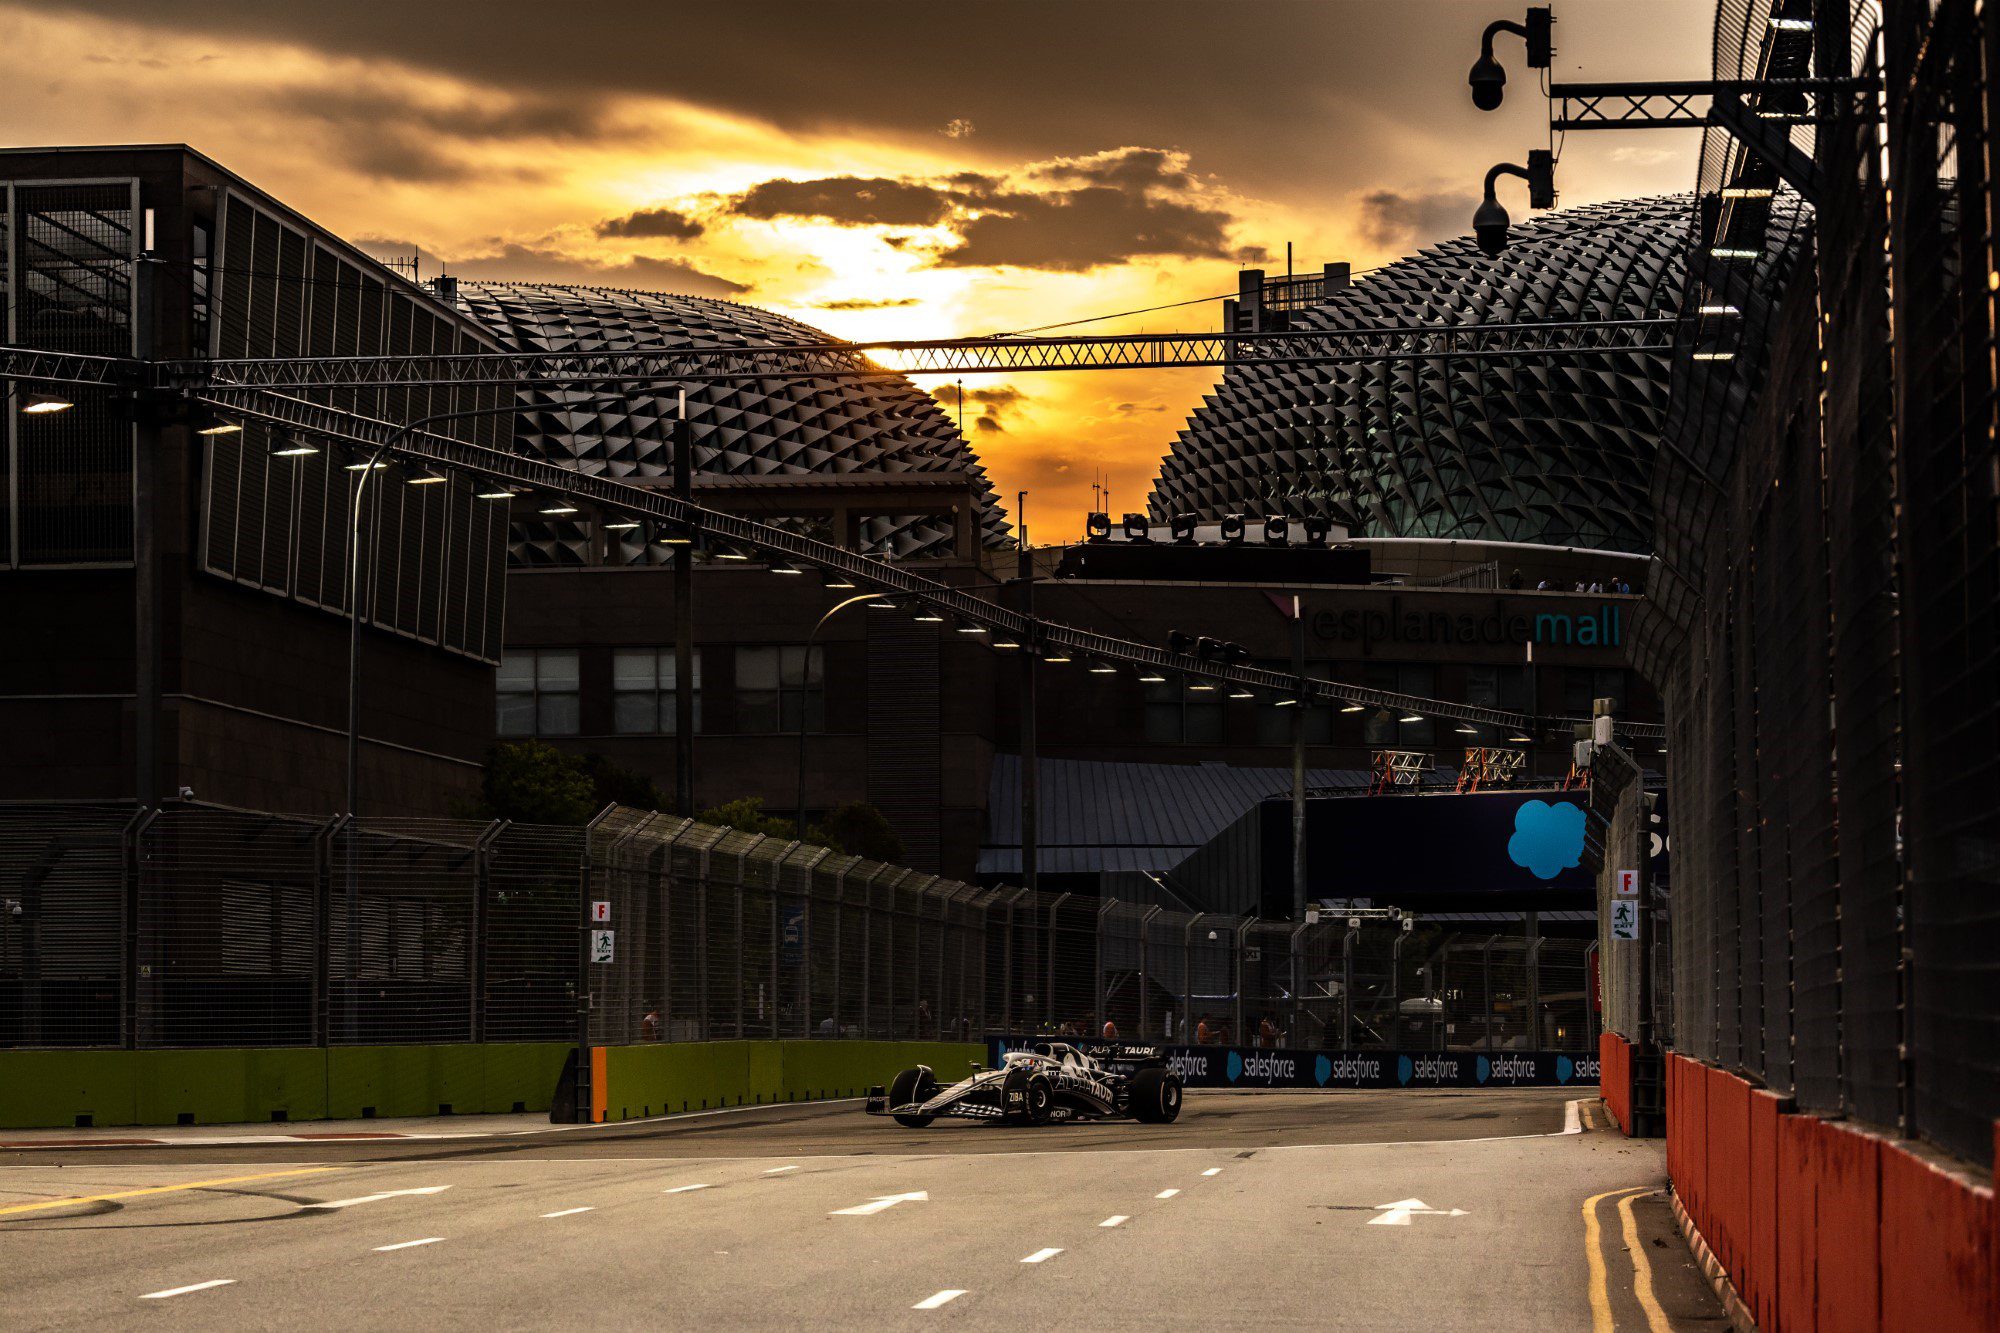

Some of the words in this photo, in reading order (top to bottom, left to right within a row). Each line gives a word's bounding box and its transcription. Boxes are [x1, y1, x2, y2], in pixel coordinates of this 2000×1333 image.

[1624, 874, 1631, 891] F
[598, 905, 605, 918] F
[1244, 1051, 1295, 1085] salesforce
[1333, 1053, 1380, 1085] salesforce
[1414, 1054, 1458, 1084] salesforce
[1491, 1054, 1536, 1085] salesforce
